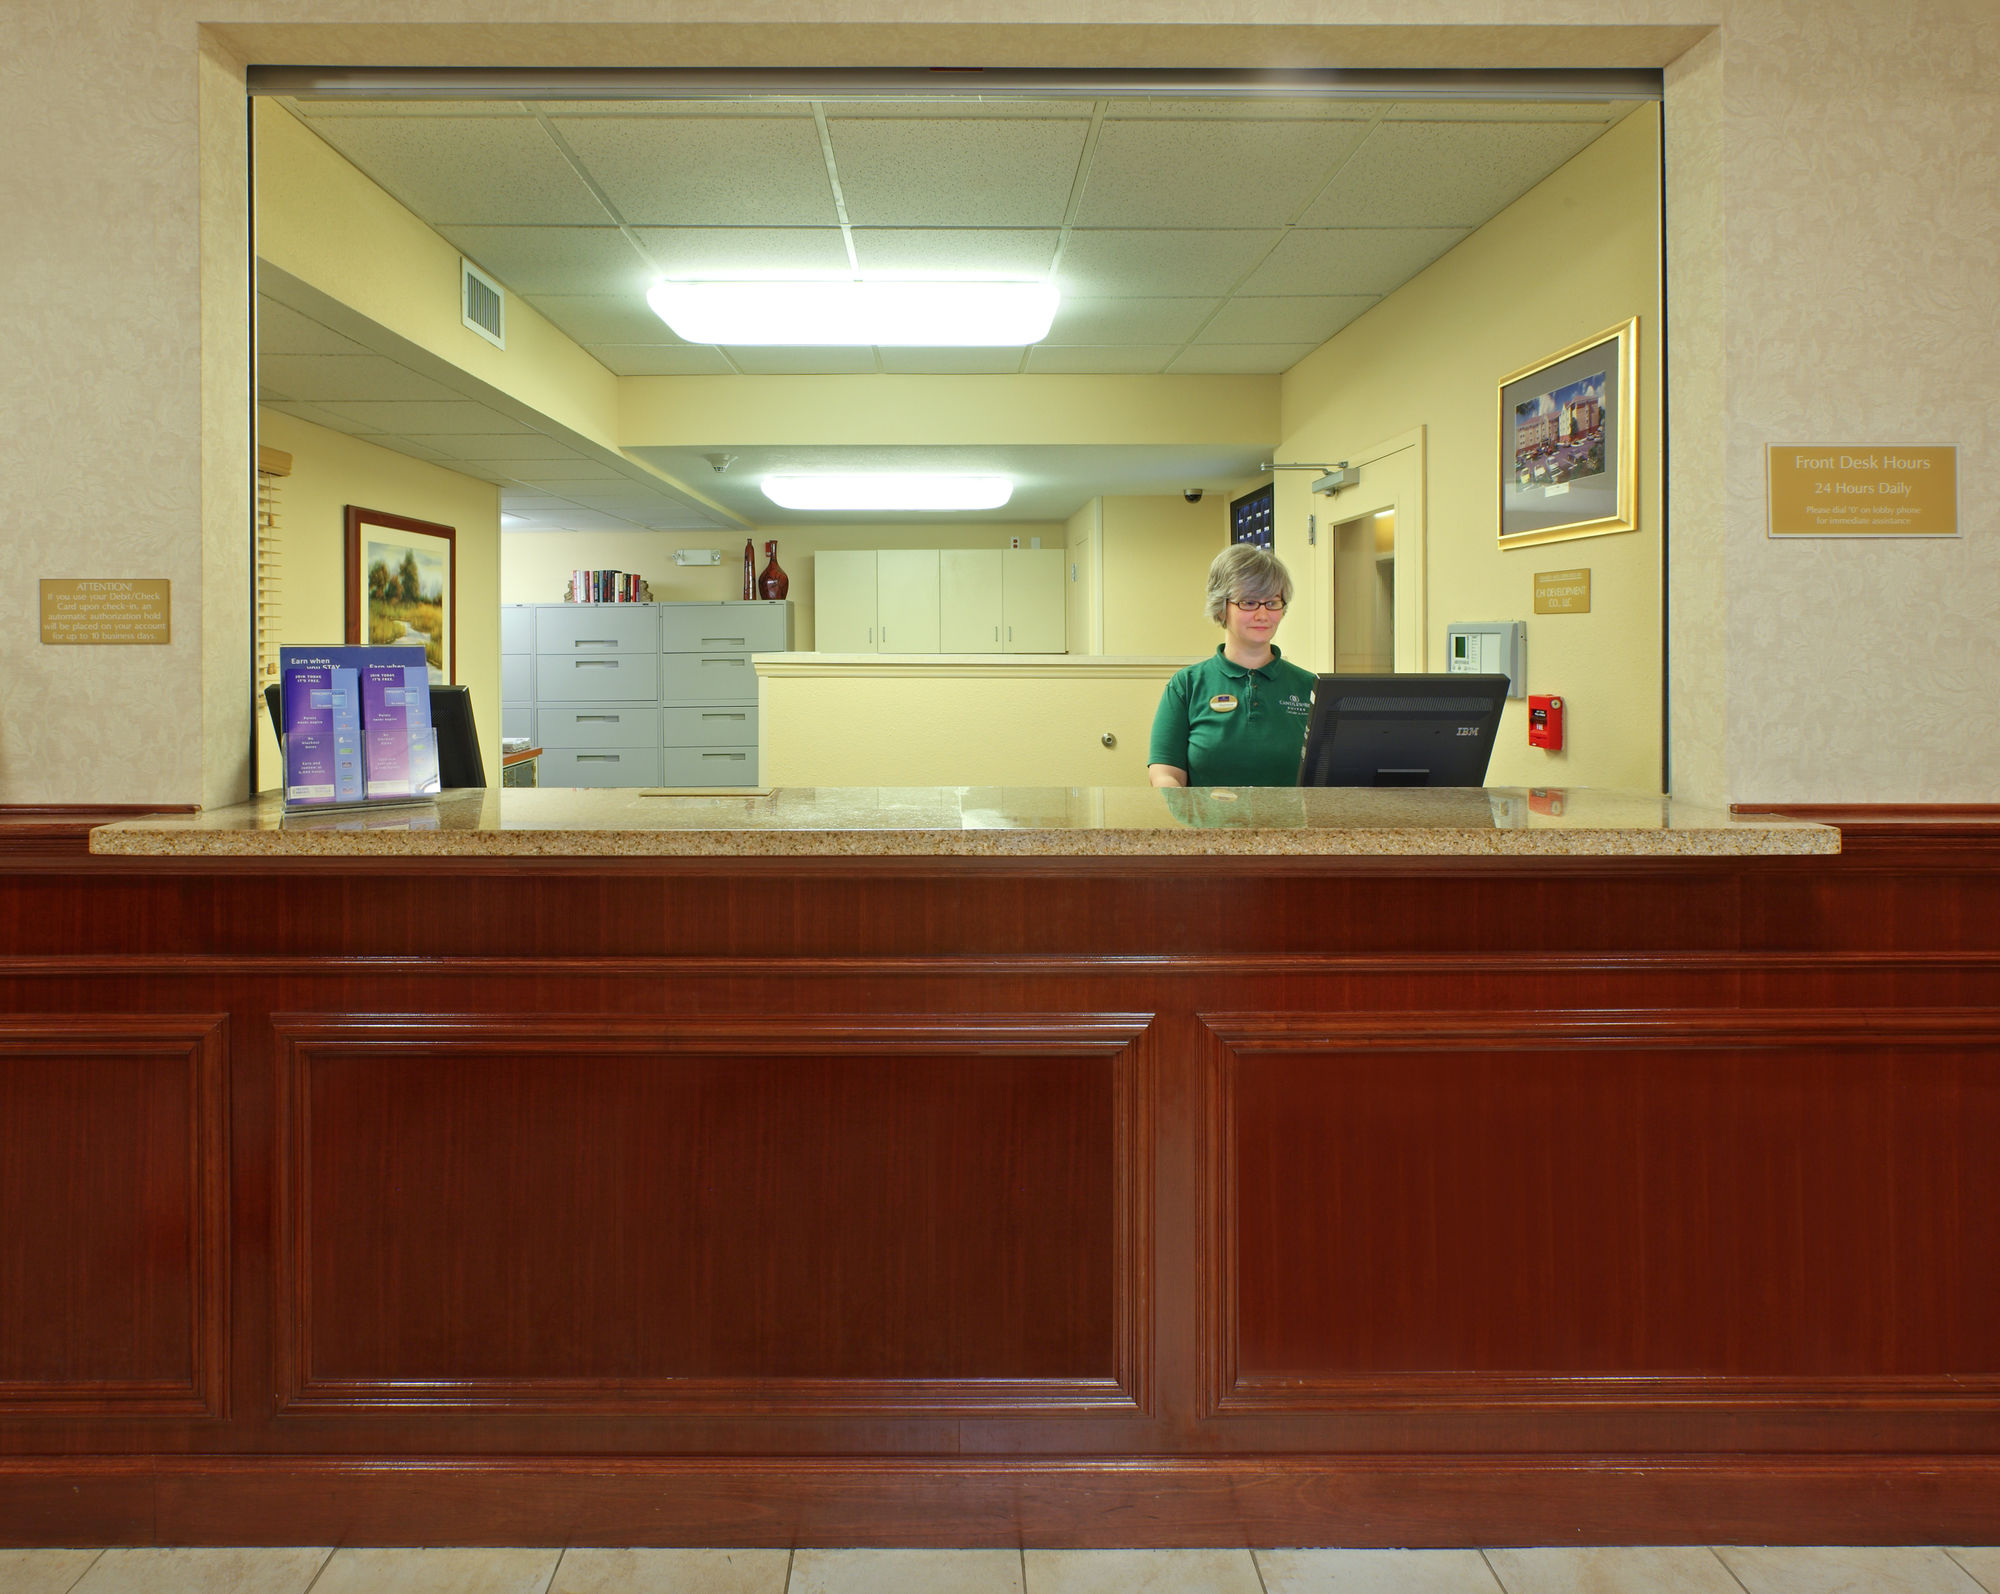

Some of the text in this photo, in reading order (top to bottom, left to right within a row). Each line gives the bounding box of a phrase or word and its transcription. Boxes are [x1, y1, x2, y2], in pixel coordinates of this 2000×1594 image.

[1795, 455, 1930, 470] Front Desk Hours
[1815, 482, 1912, 498] 24 Hours Daily
[1806, 506, 1830, 514] Please
[1832, 506, 1846, 514] dial
[1872, 506, 1894, 516] lobby
[1896, 506, 1921, 516] phone
[1816, 517, 1827, 525] for
[1829, 517, 1869, 525] immediate
[77, 583, 133, 591] ATTENTION!
[56, 594, 71, 602] you
[90, 594, 107, 602] your
[110, 592, 160, 600] Debit/Check
[57, 602, 77, 610] Card
[80, 604, 99, 612] upon
[48, 612, 161, 620] automatic authorization hold
[44, 622, 58, 630] will
[60, 622, 70, 630] be
[73, 622, 98, 632] placed
[115, 624, 132, 632] your
[53, 632, 64, 640] for
[66, 634, 77, 642] up
[102, 632, 135, 640] business
[1456, 727, 1480, 736] IBM
